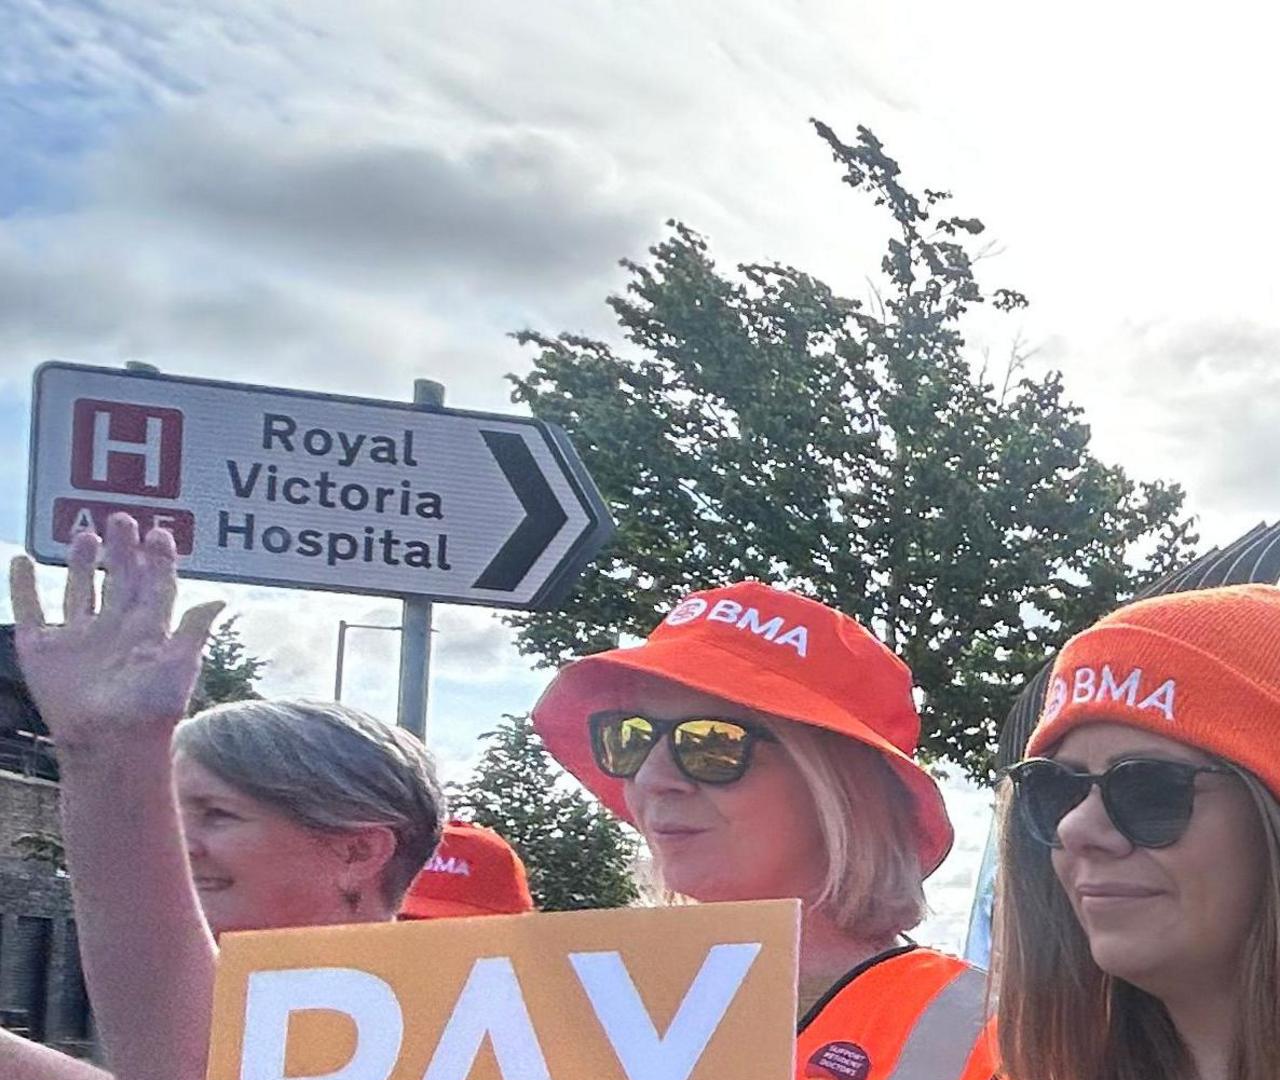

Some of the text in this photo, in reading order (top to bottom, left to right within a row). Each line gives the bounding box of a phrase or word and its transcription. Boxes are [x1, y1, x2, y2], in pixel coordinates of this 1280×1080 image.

[91, 410, 163, 488] H
[262, 412, 418, 467] Royal
[226, 459, 445, 521] Victoria
[217, 510, 452, 571] Hospital
[706, 599, 808, 657] BMA
[1072, 664, 1176, 720] BMA
